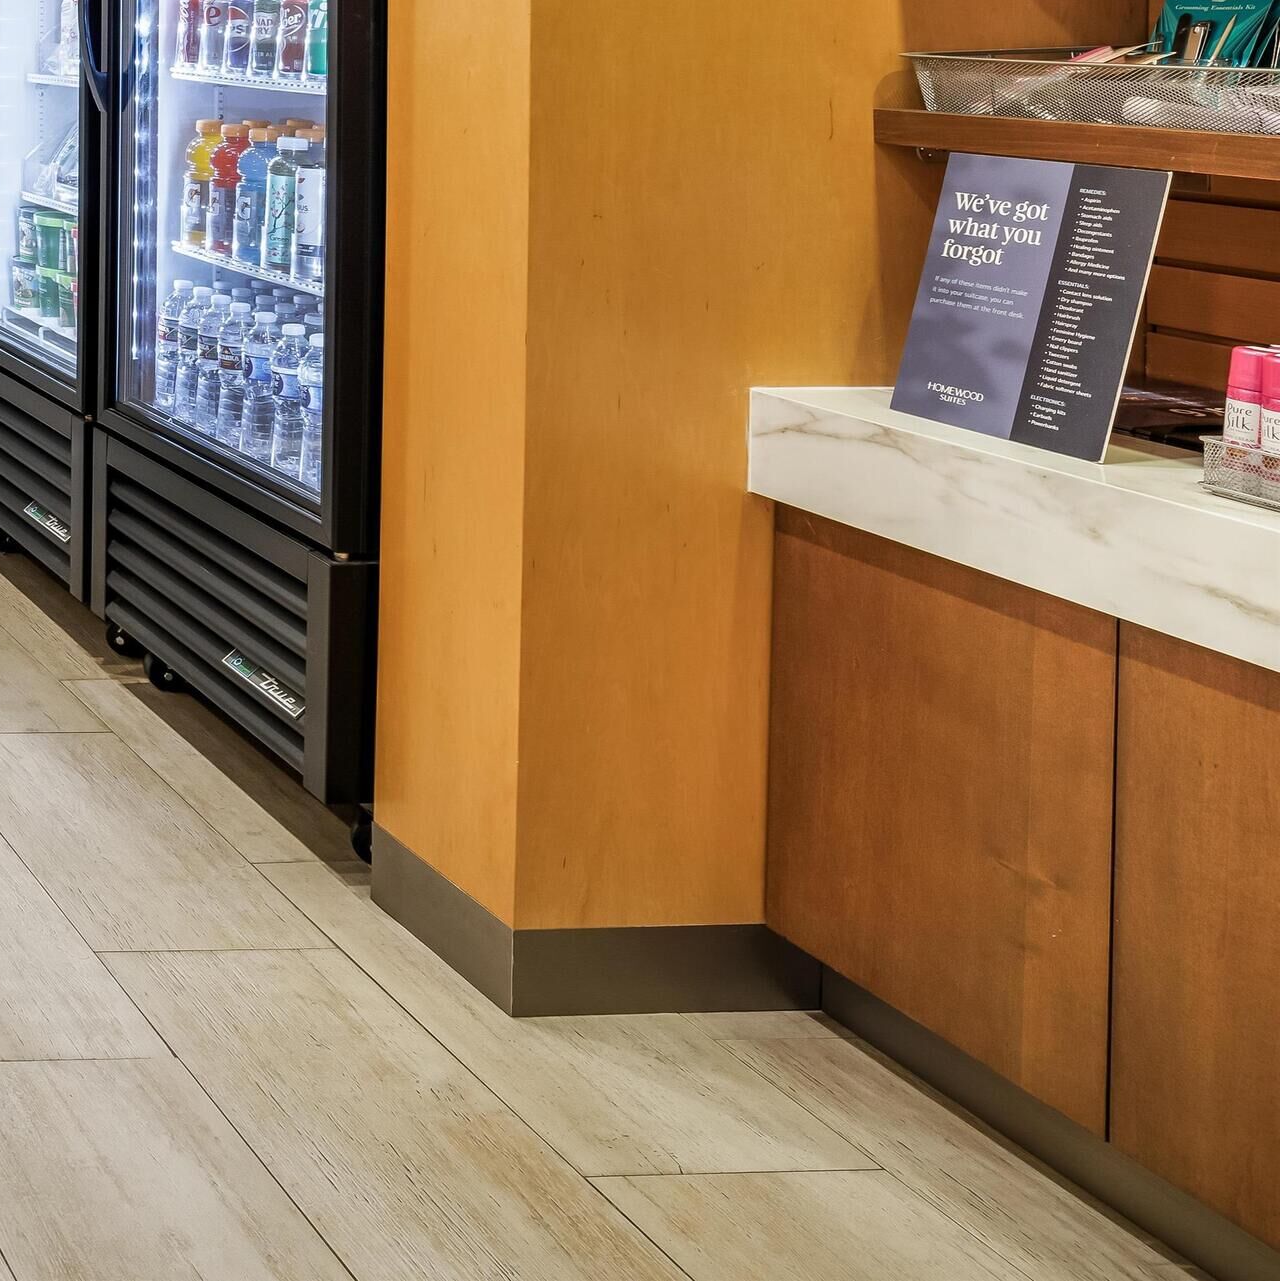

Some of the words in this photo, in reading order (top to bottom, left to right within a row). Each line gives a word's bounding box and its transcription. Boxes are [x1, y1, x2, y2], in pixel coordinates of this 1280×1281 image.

[1176, 4, 1209, 12] Grooming
[955, 191, 1010, 216] We've
[1013, 201, 1050, 222] got
[948, 217, 998, 240] what
[1002, 227, 1042, 246] you
[941, 239, 1005, 266] forgot
[930, 298, 955, 306] purchase
[992, 308, 1007, 316] front
[928, 381, 984, 402] HOMEWOOD
[939, 394, 966, 406] SUITES
[1227, 403, 1252, 417] Pure
[1226, 415, 1251, 433] Silk
